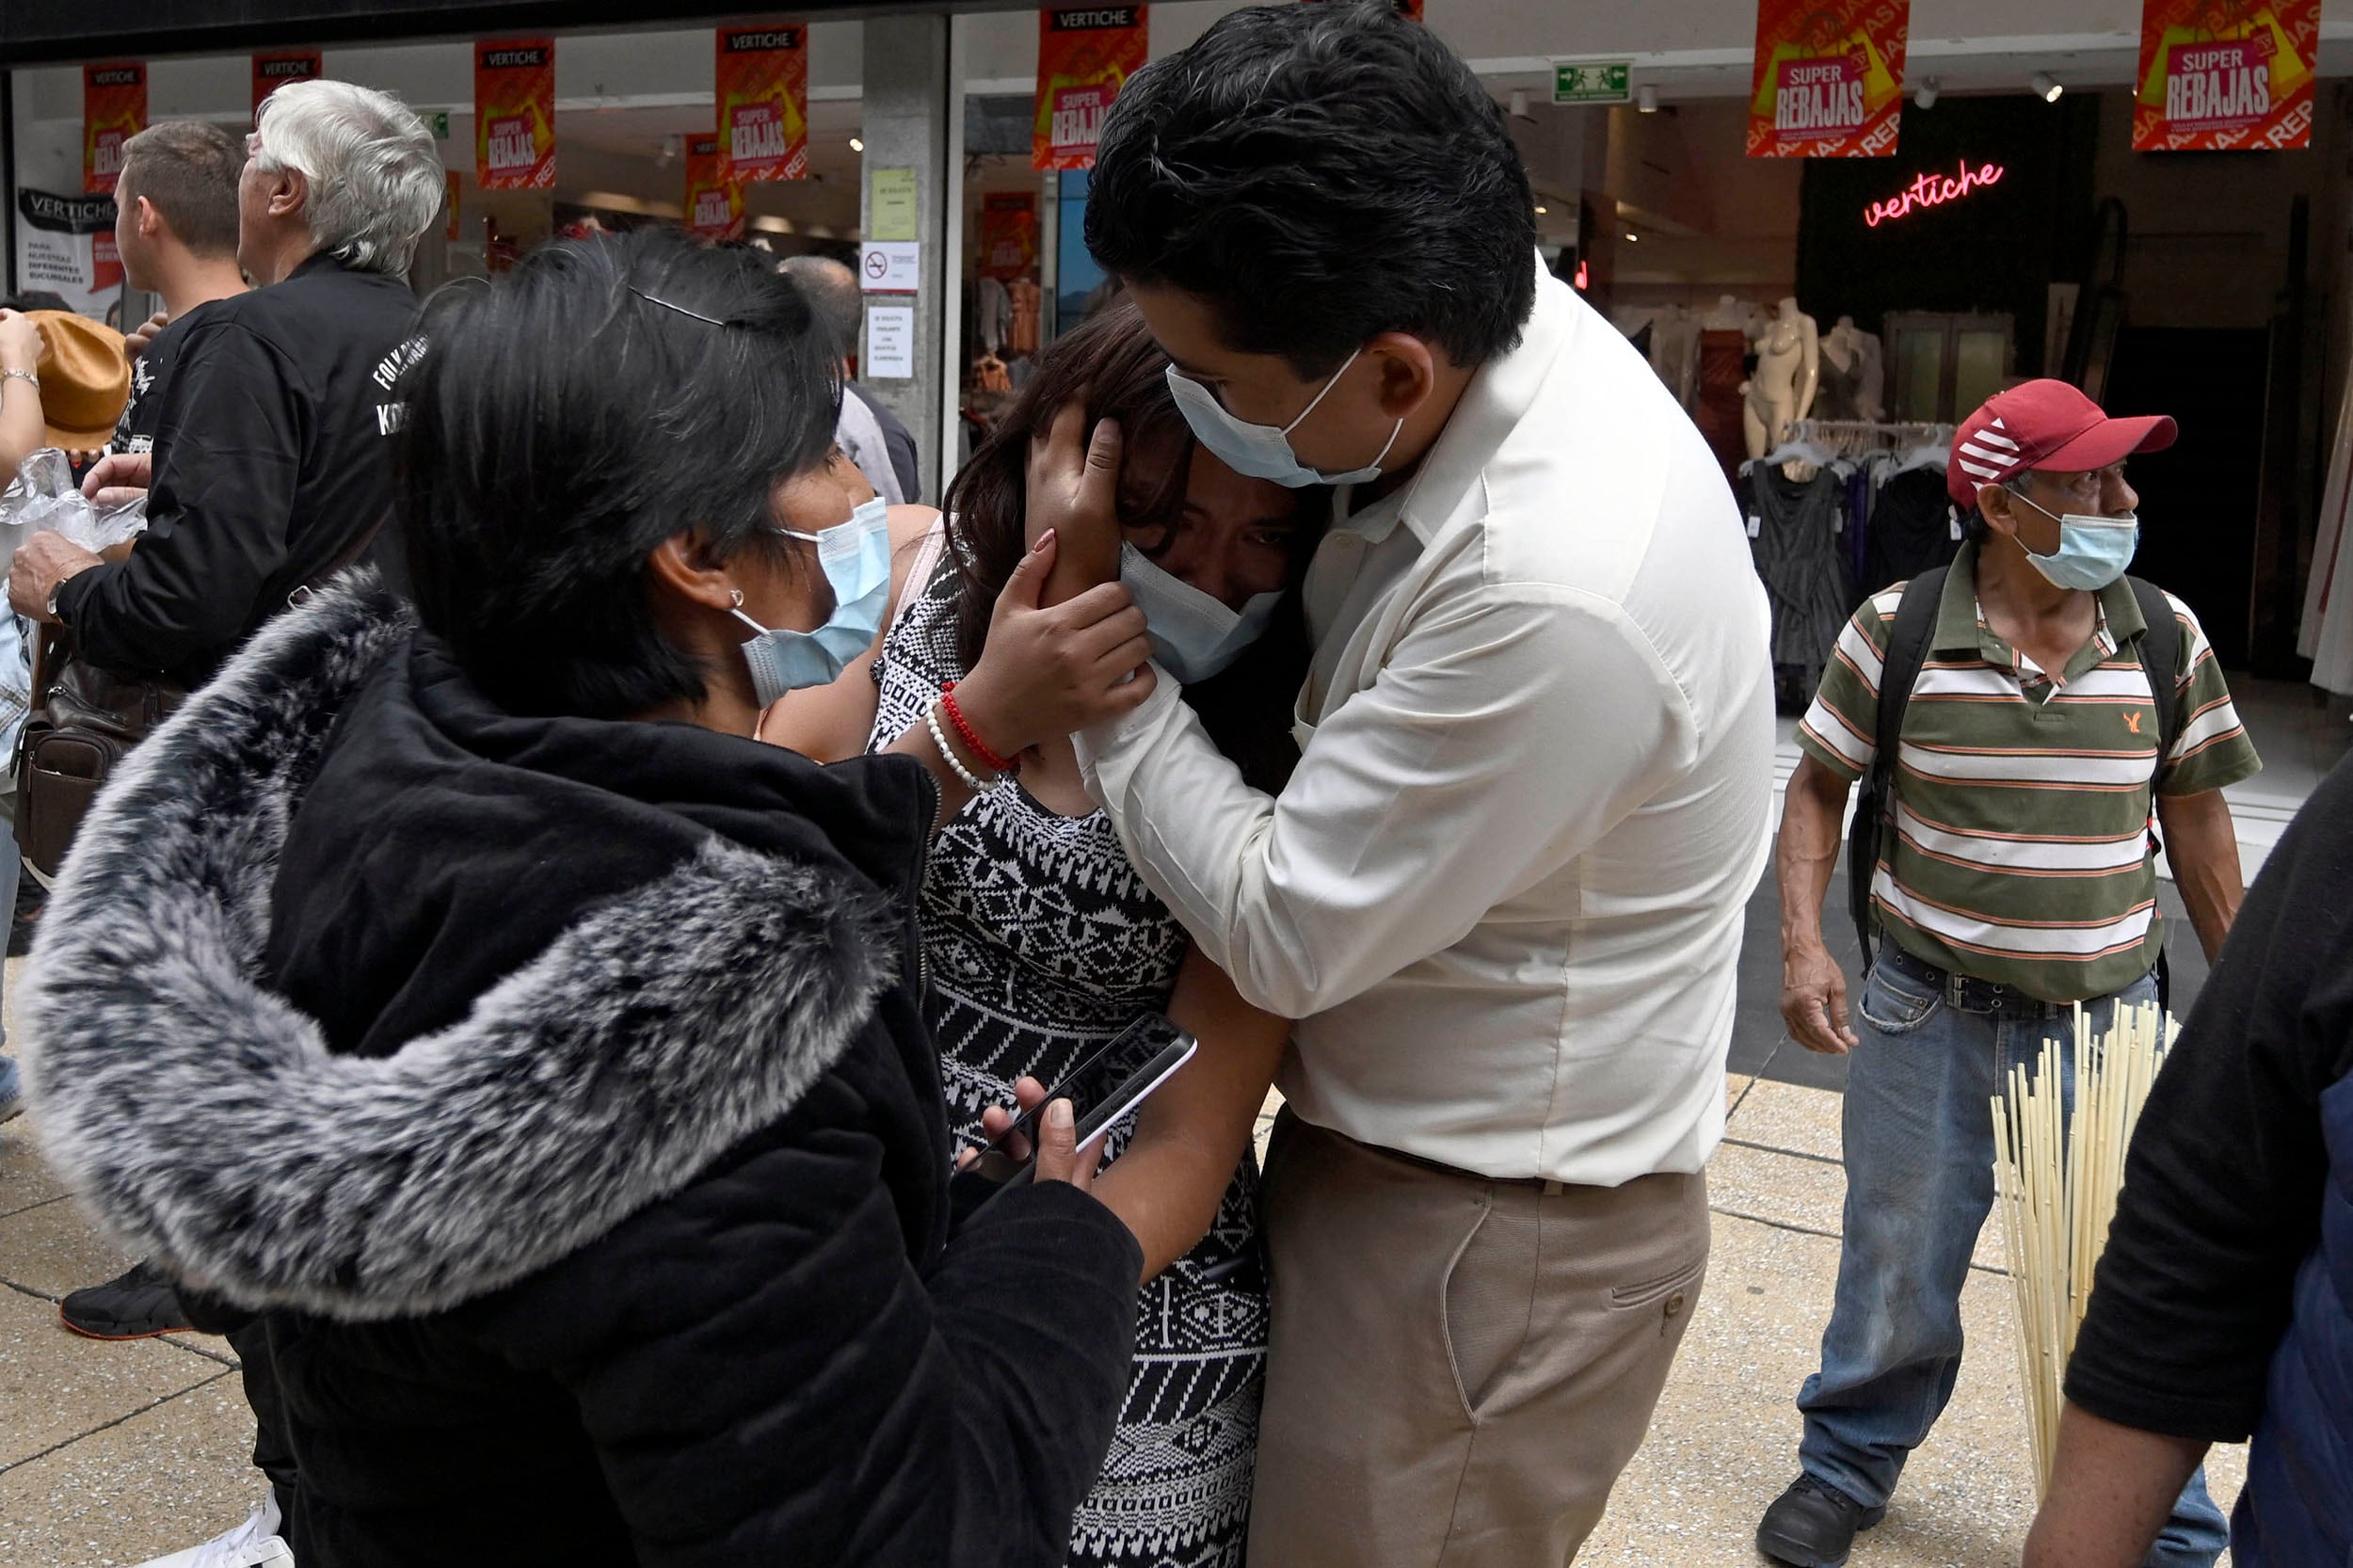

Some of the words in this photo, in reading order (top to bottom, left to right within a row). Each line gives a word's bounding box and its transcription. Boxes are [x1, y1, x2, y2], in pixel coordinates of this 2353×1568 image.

[1060, 9, 1128, 28] VERTICHE
[732, 32, 791, 50] VERTICHE
[488, 51, 539, 67] VERTICHE
[2182, 49, 2243, 72] SUPER
[1790, 66, 1842, 85] SUPER
[1062, 91, 1100, 109] SUPER
[2166, 65, 2270, 120] REBAJAS
[1775, 80, 1865, 130] REBAJAS
[737, 108, 770, 125] SUPER
[493, 120, 522, 137] SUPER
[731, 120, 785, 160] REBAJAS
[488, 132, 536, 169] REBAJAS
[1865, 158, 2004, 227] vertiche
